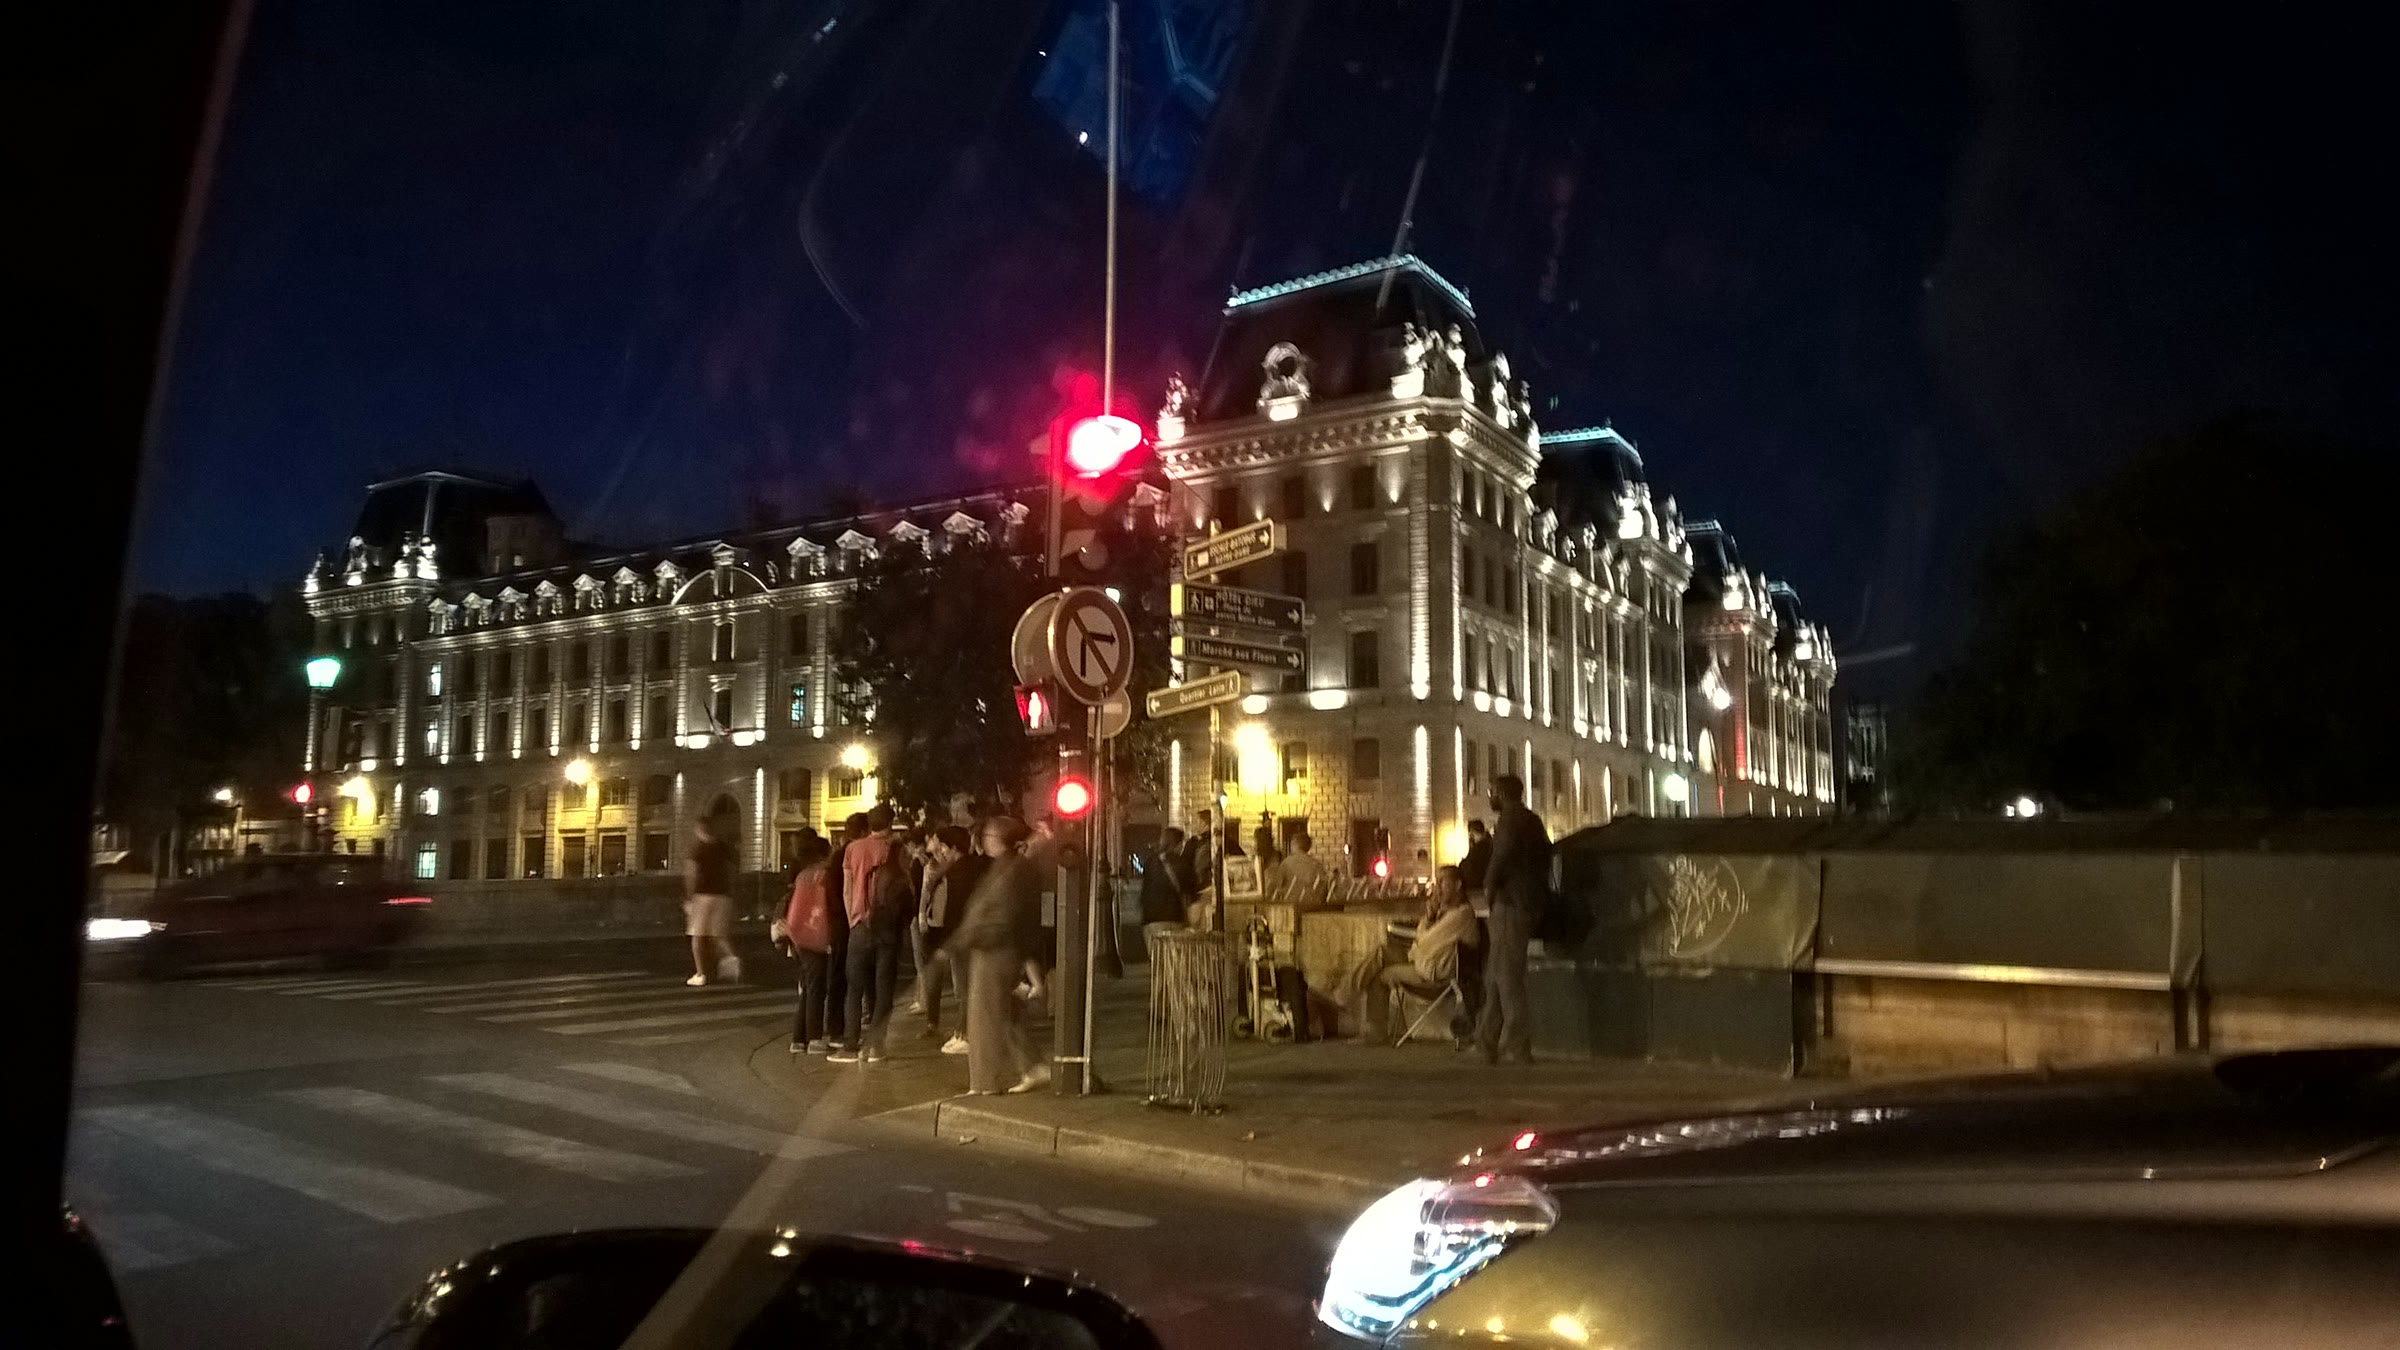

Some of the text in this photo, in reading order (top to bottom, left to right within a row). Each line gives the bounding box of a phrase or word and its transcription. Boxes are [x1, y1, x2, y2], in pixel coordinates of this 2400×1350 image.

[1202, 641, 1276, 664] Marché aux Fleurs
[1180, 684, 1225, 704] Quartier Latin
